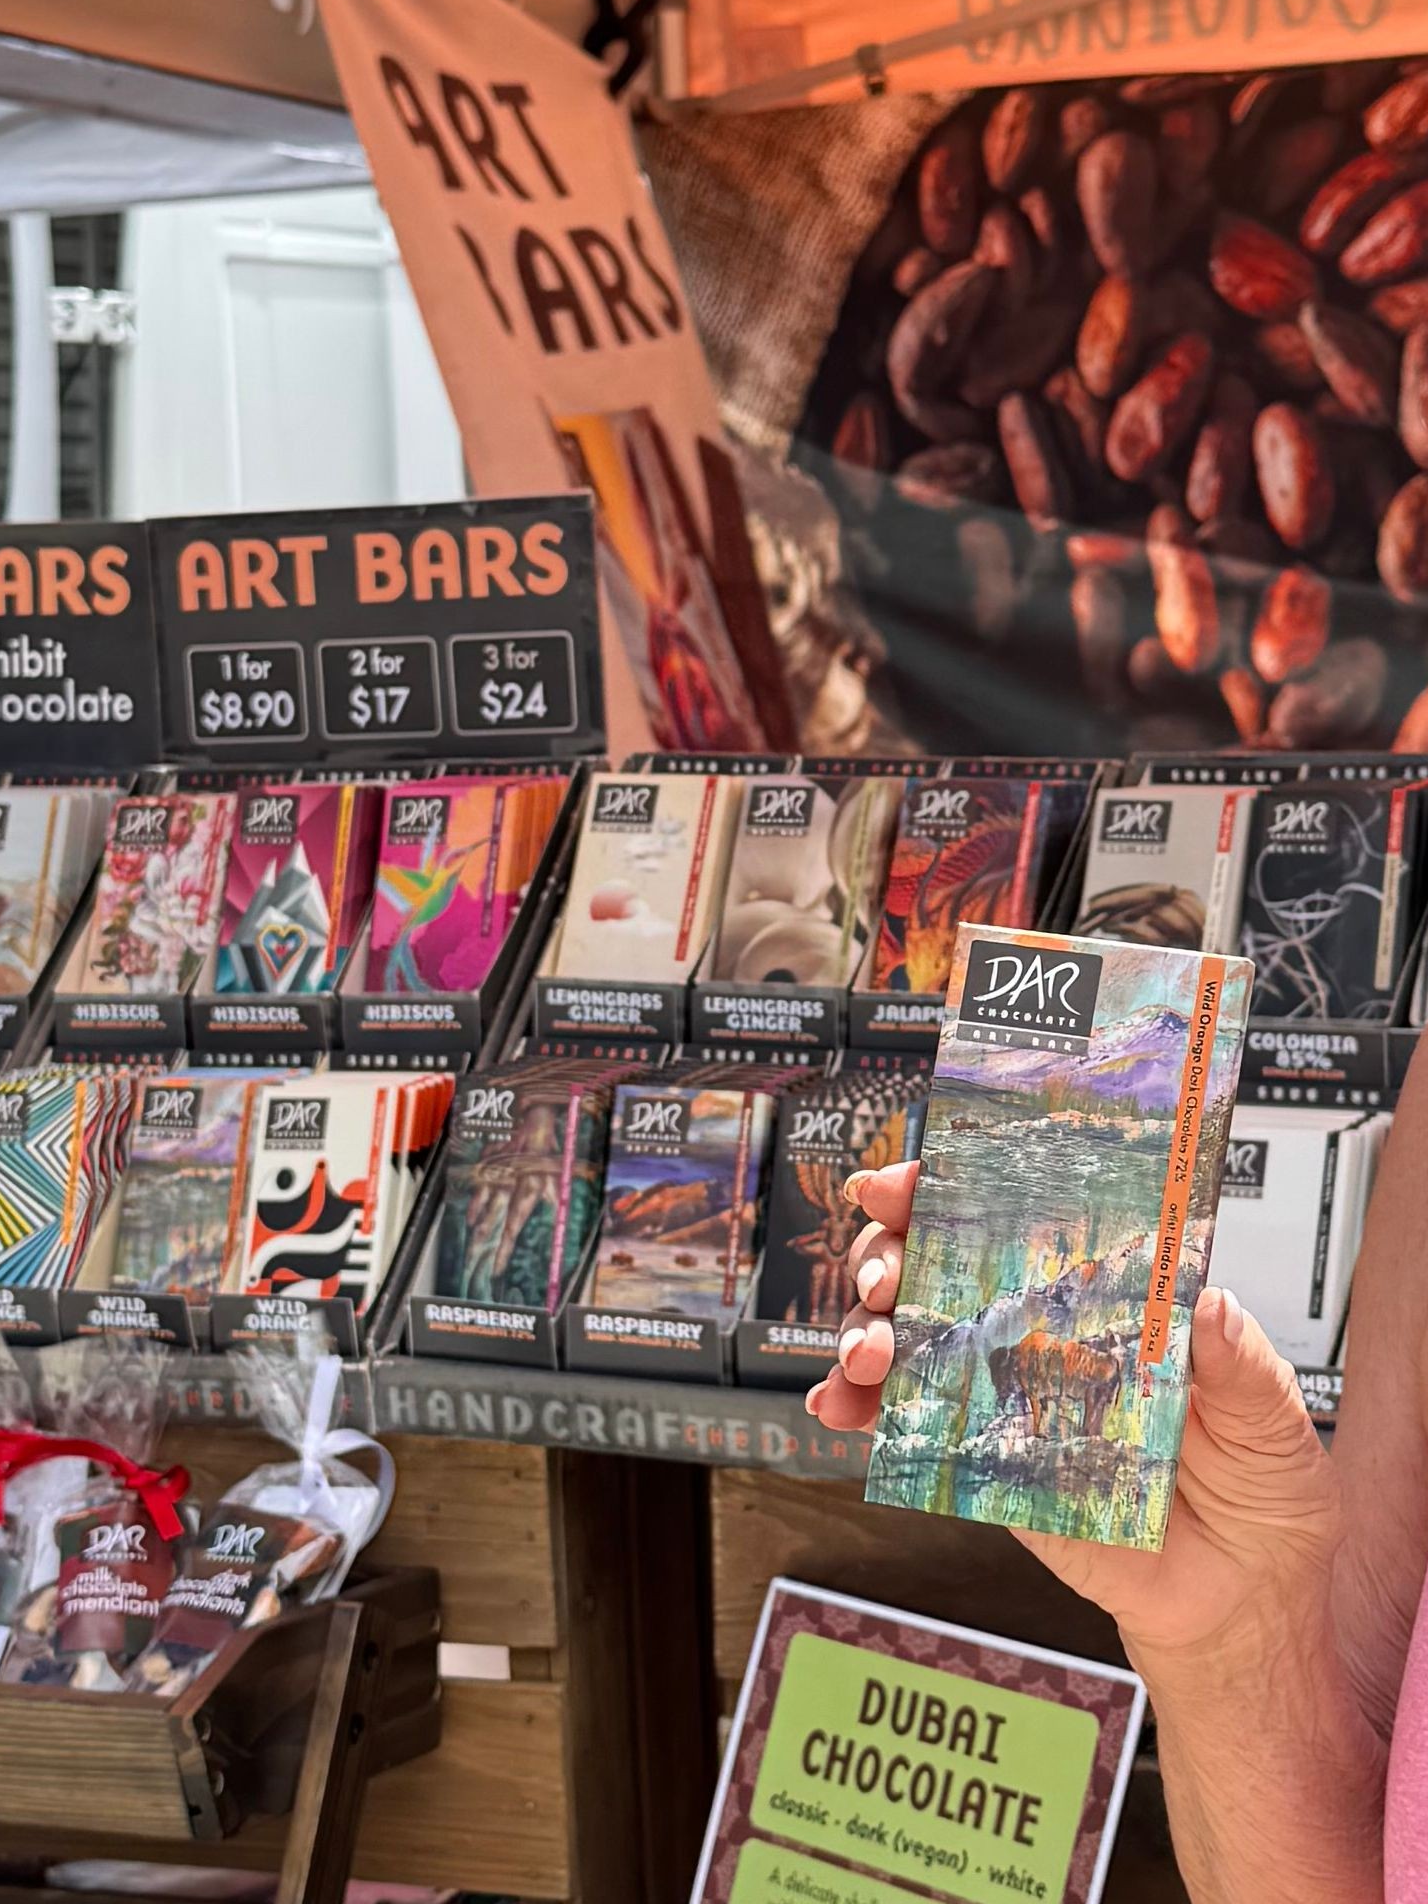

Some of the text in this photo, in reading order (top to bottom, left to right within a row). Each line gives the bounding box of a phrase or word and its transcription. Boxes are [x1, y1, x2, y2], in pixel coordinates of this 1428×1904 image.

[378, 54, 569, 202] ART
[178, 521, 569, 612] ART BARS
[219, 651, 272, 681] 1 for
[348, 647, 404, 676] 2 for
[483, 642, 540, 671] 3 for
[199, 688, 296, 734] $8.90
[348, 683, 410, 728] $17
[478, 679, 548, 724] $24
[595, 785, 652, 816] DAR
[753, 787, 807, 817] DAR
[547, 988, 663, 1011] LEMONGRASS
[973, 954, 1081, 1016] DAR
[1203, 980, 1219, 1012] Wild
[74, 1004, 160, 1021] HIBISCUS
[212, 1006, 300, 1022] HIBISCUS
[365, 1004, 455, 1022] HIBISCUS
[568, 1005, 641, 1025] GINGER
[704, 996, 824, 1018] LEMONGRASS
[977, 1006, 1077, 1028] CHOCOLATE
[727, 1014, 803, 1032] GINGER
[972, 1029, 1073, 1052] ART BAR
[1191, 1013, 1213, 1065] Orange
[1248, 1031, 1359, 1055] COLOMBIA
[1189, 1064, 1206, 1094] Dark
[98, 1296, 147, 1312] WILD
[256, 1299, 308, 1315] WILD
[425, 1303, 536, 1331] RASPBERRY
[89, 1310, 159, 1329] ORANGE
[584, 1314, 703, 1340] RASPBERRY
[767, 1326, 840, 1347] SERRA
[388, 1386, 788, 1463] HANDCRAFTED
[858, 1678, 1007, 1764] DUBAI
[802, 1728, 1043, 1846] CHOCOLATE
[769, 1790, 1049, 1900] classic dark (vegan) white
